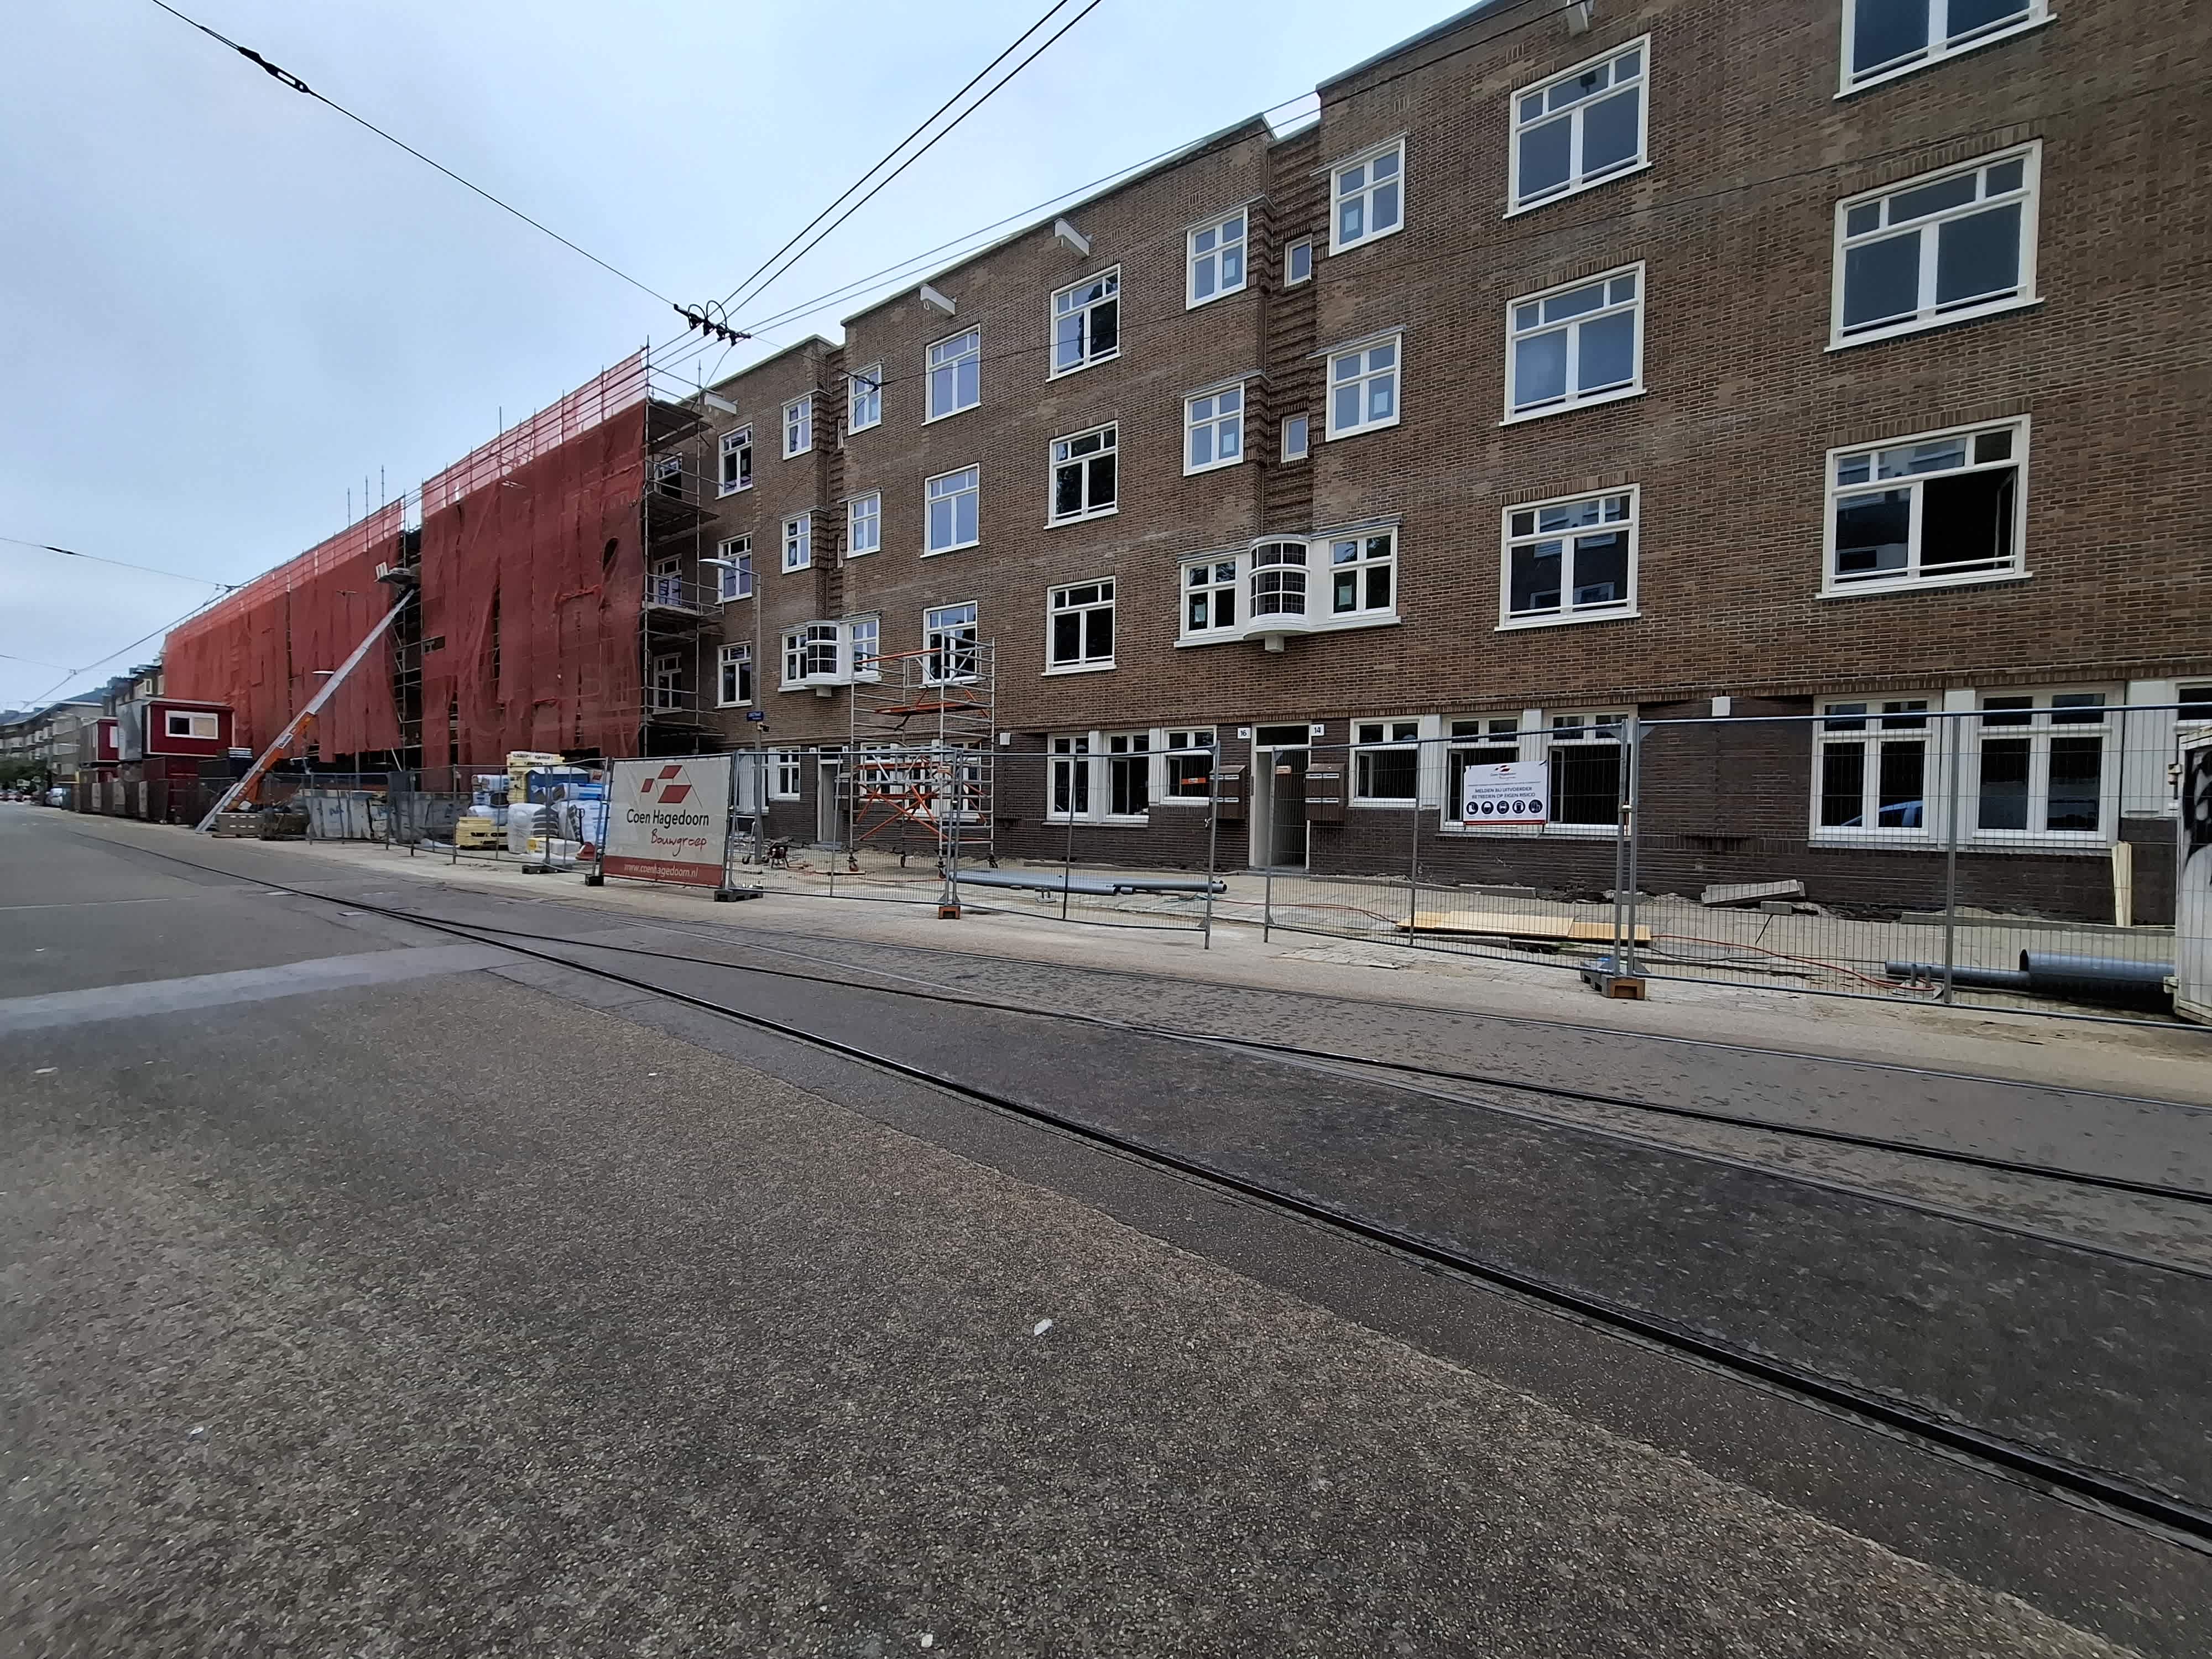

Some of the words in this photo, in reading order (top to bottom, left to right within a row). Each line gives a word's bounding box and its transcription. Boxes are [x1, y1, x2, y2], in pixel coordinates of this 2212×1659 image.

[627, 808, 651, 824] Coen
[653, 809, 709, 829] Hagedoorn
[651, 828, 707, 857] Bouwgroep
[624, 863, 699, 878] www.coenhagedoorn.nl
